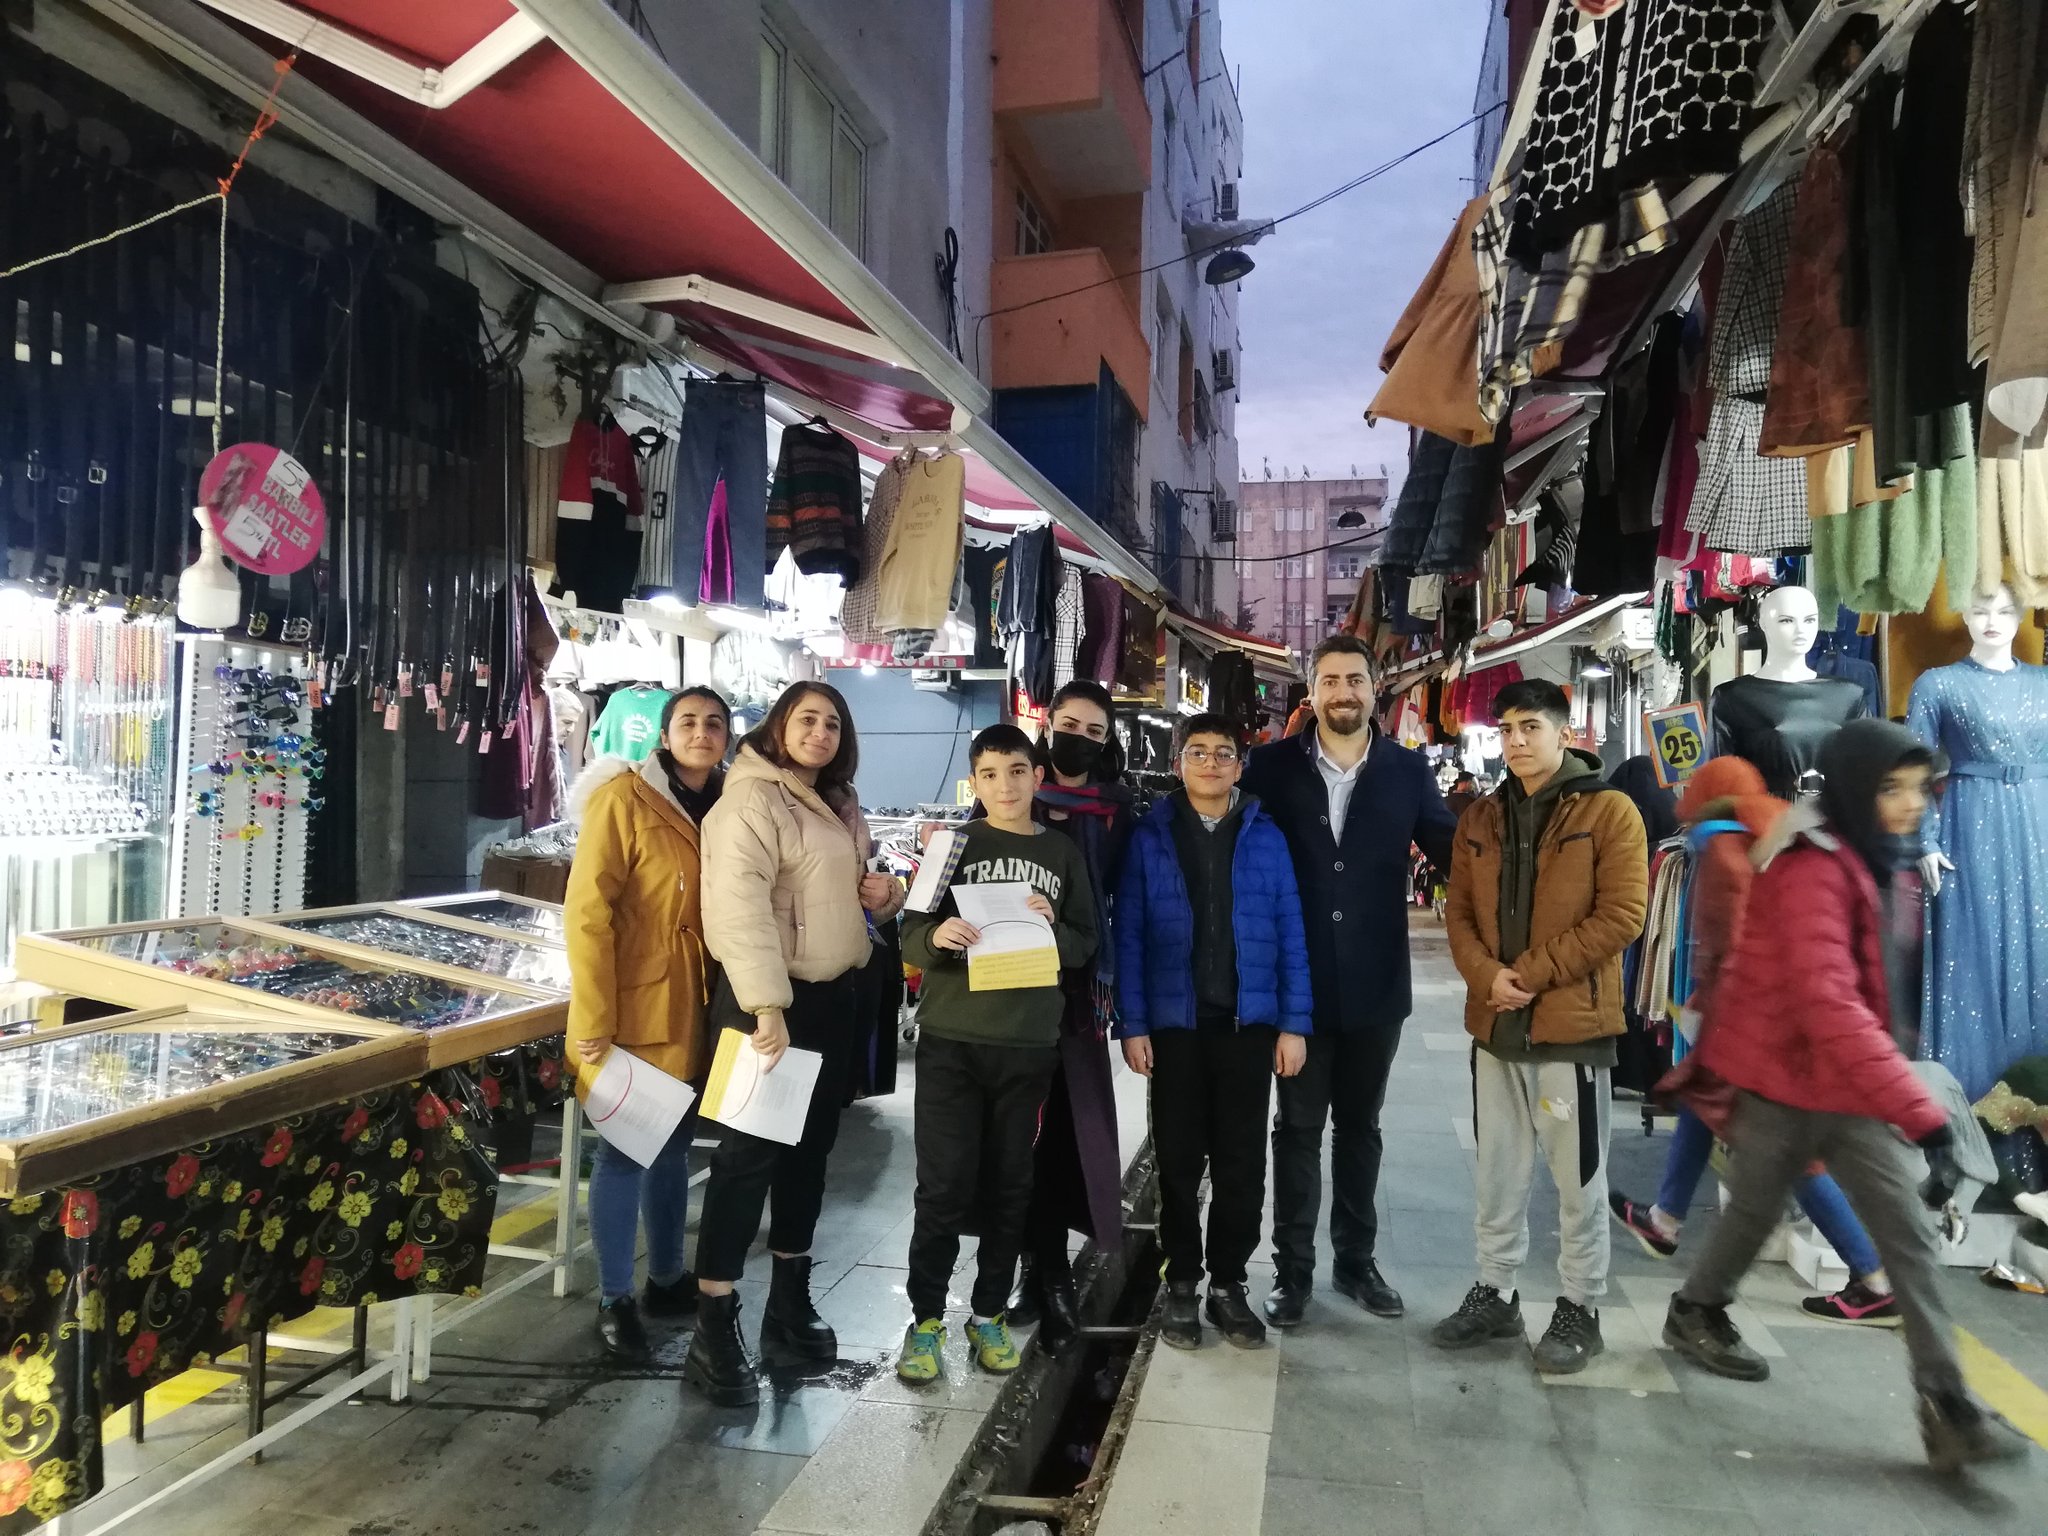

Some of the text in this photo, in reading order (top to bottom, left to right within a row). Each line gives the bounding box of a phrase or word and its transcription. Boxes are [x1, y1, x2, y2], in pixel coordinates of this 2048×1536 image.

[245, 494, 312, 551] SAATLER
[651, 491, 667, 520] 3
[1664, 731, 1698, 765] 25
[963, 857, 1062, 900] TRAINING
